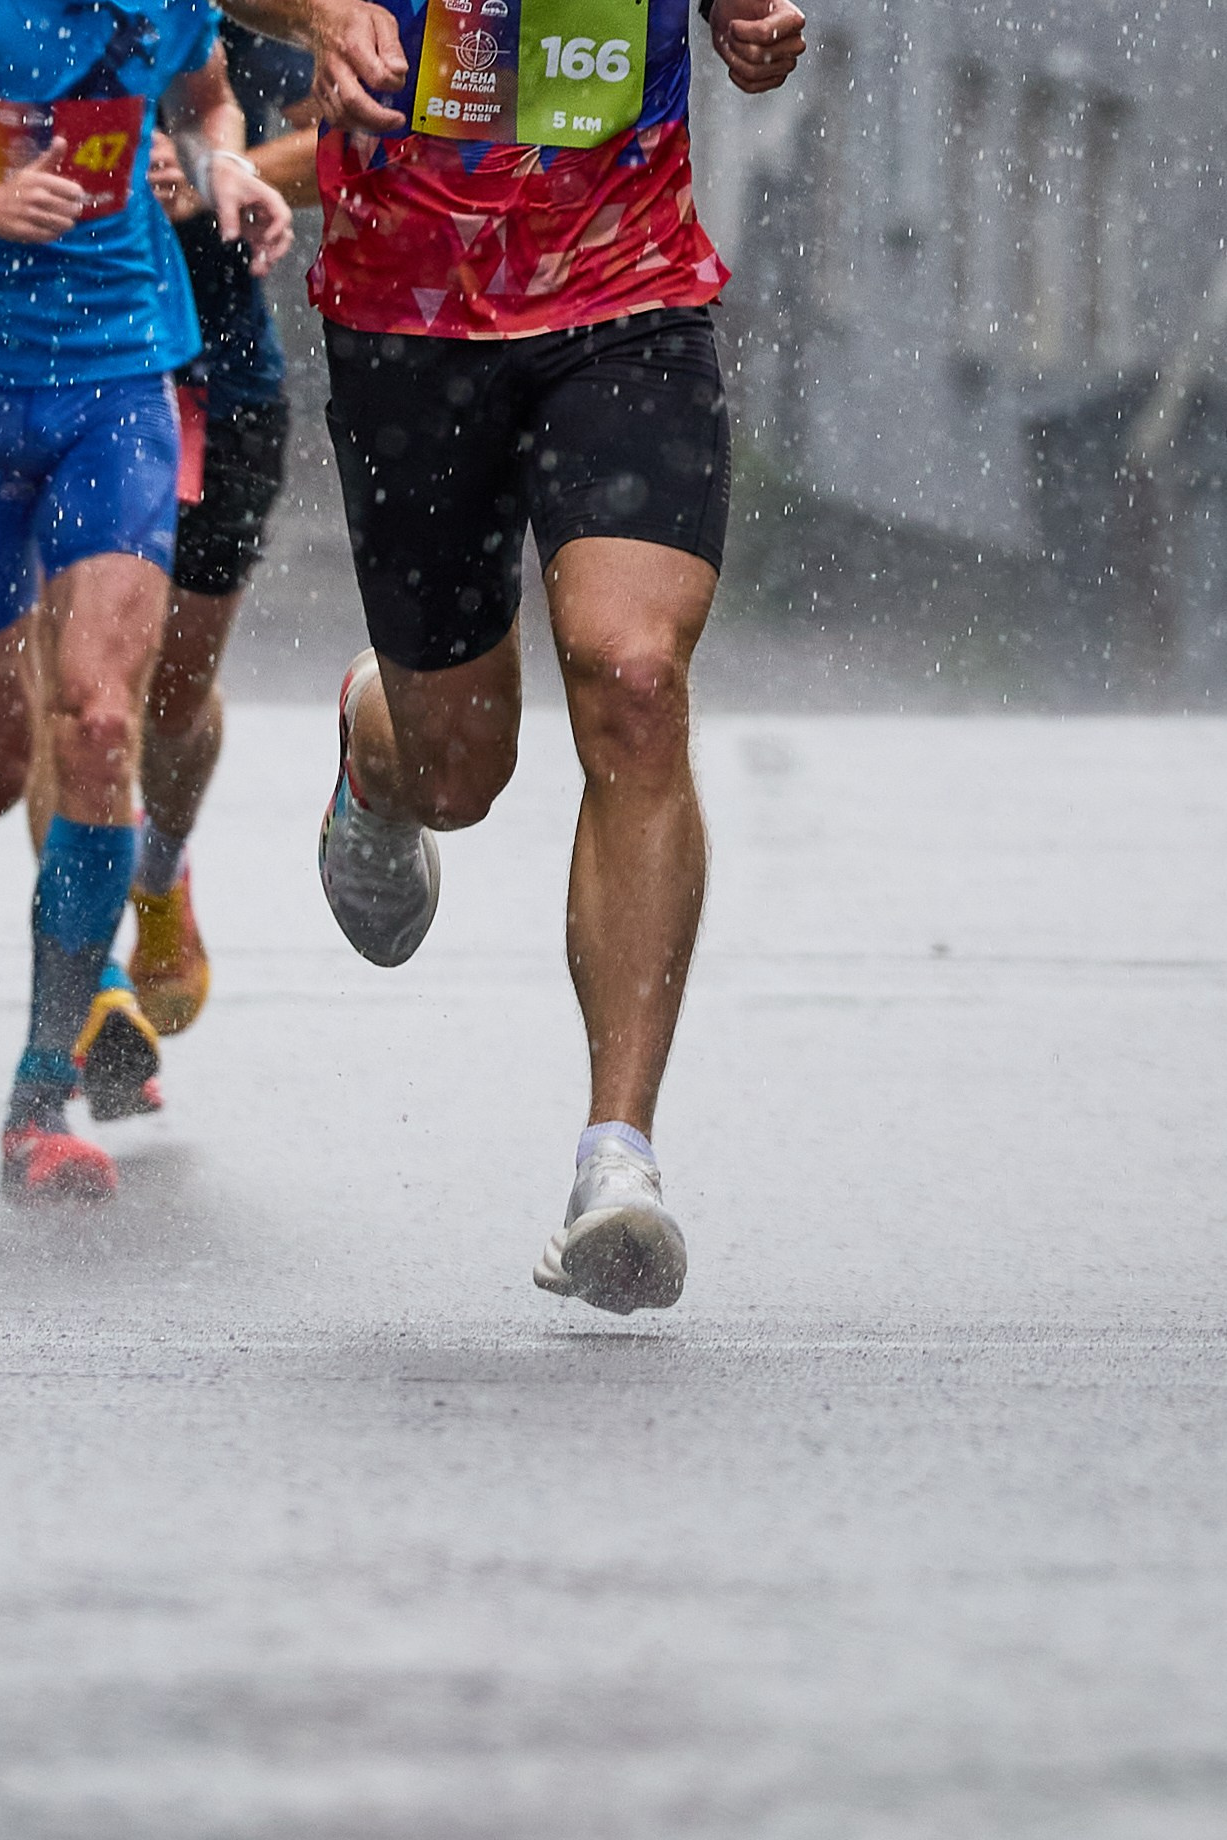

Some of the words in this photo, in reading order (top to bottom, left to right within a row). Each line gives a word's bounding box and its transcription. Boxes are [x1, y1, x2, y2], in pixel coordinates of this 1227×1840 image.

[540, 35, 631, 83] 166
[451, 69, 497, 84] АРЕНА
[450, 81, 496, 93] БИАТЛОНА
[426, 96, 461, 120] 28
[463, 102, 502, 113] ИЮНЯ
[552, 111, 567, 129] 5
[73, 132, 129, 172] 47
